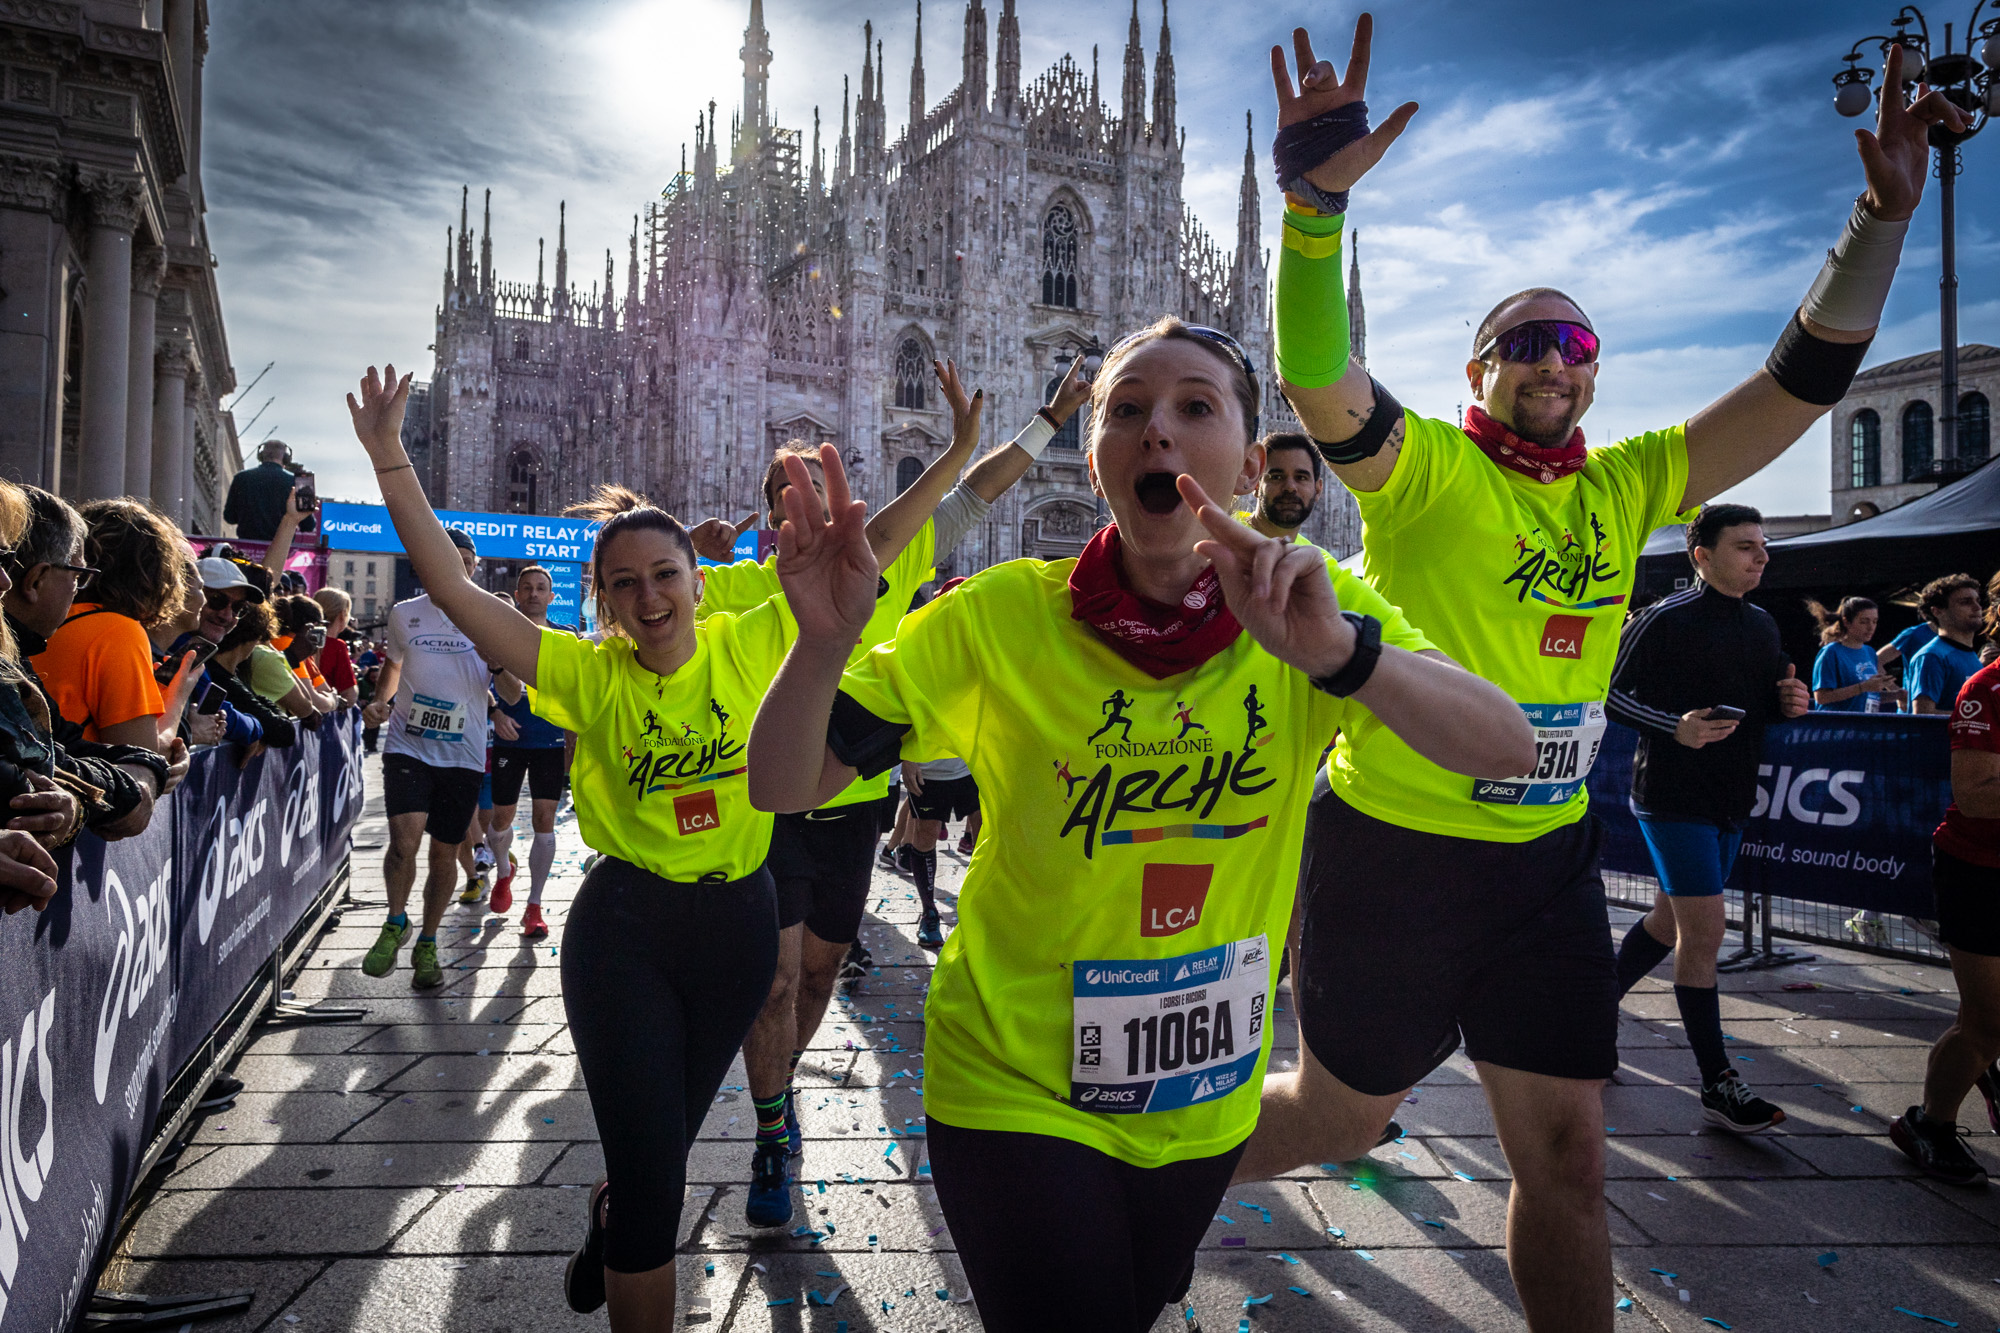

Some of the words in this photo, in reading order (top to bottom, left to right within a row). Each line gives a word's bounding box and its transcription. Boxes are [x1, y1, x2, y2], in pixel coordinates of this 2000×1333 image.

[336, 521, 381, 533] UniCredit
[441, 519, 517, 538] ICREDIT
[523, 525, 578, 540] RELAY
[525, 543, 580, 558] START
[734, 546, 753, 555] redit
[414, 640, 467, 648] LACTALIS
[1545, 638, 1576, 654] LCA
[421, 711, 451, 731] 881A
[1524, 709, 1542, 719] redit
[1095, 738, 1213, 758] FONDAZIONE
[1491, 786, 1517, 796] asics
[1749, 764, 1865, 826] SICS
[683, 813, 715, 831] LCA
[226, 798, 267, 899] asics
[1740, 840, 1786, 863] mind,
[1791, 848, 1850, 868] sound
[1853, 851, 1906, 880] body
[1151, 906, 1196, 929] LCA
[1102, 969, 1160, 984] UniCredit
[1192, 956, 1218, 970] RELAY
[1163, 995, 1181, 1008] CORSI
[1186, 989, 1207, 1004] RICORSI
[1123, 1000, 1234, 1076] 1106A
[1215, 1073, 1230, 1081] WIZZ
[1215, 1075, 1238, 1087] MILANO
[1098, 1090, 1137, 1102] asics
